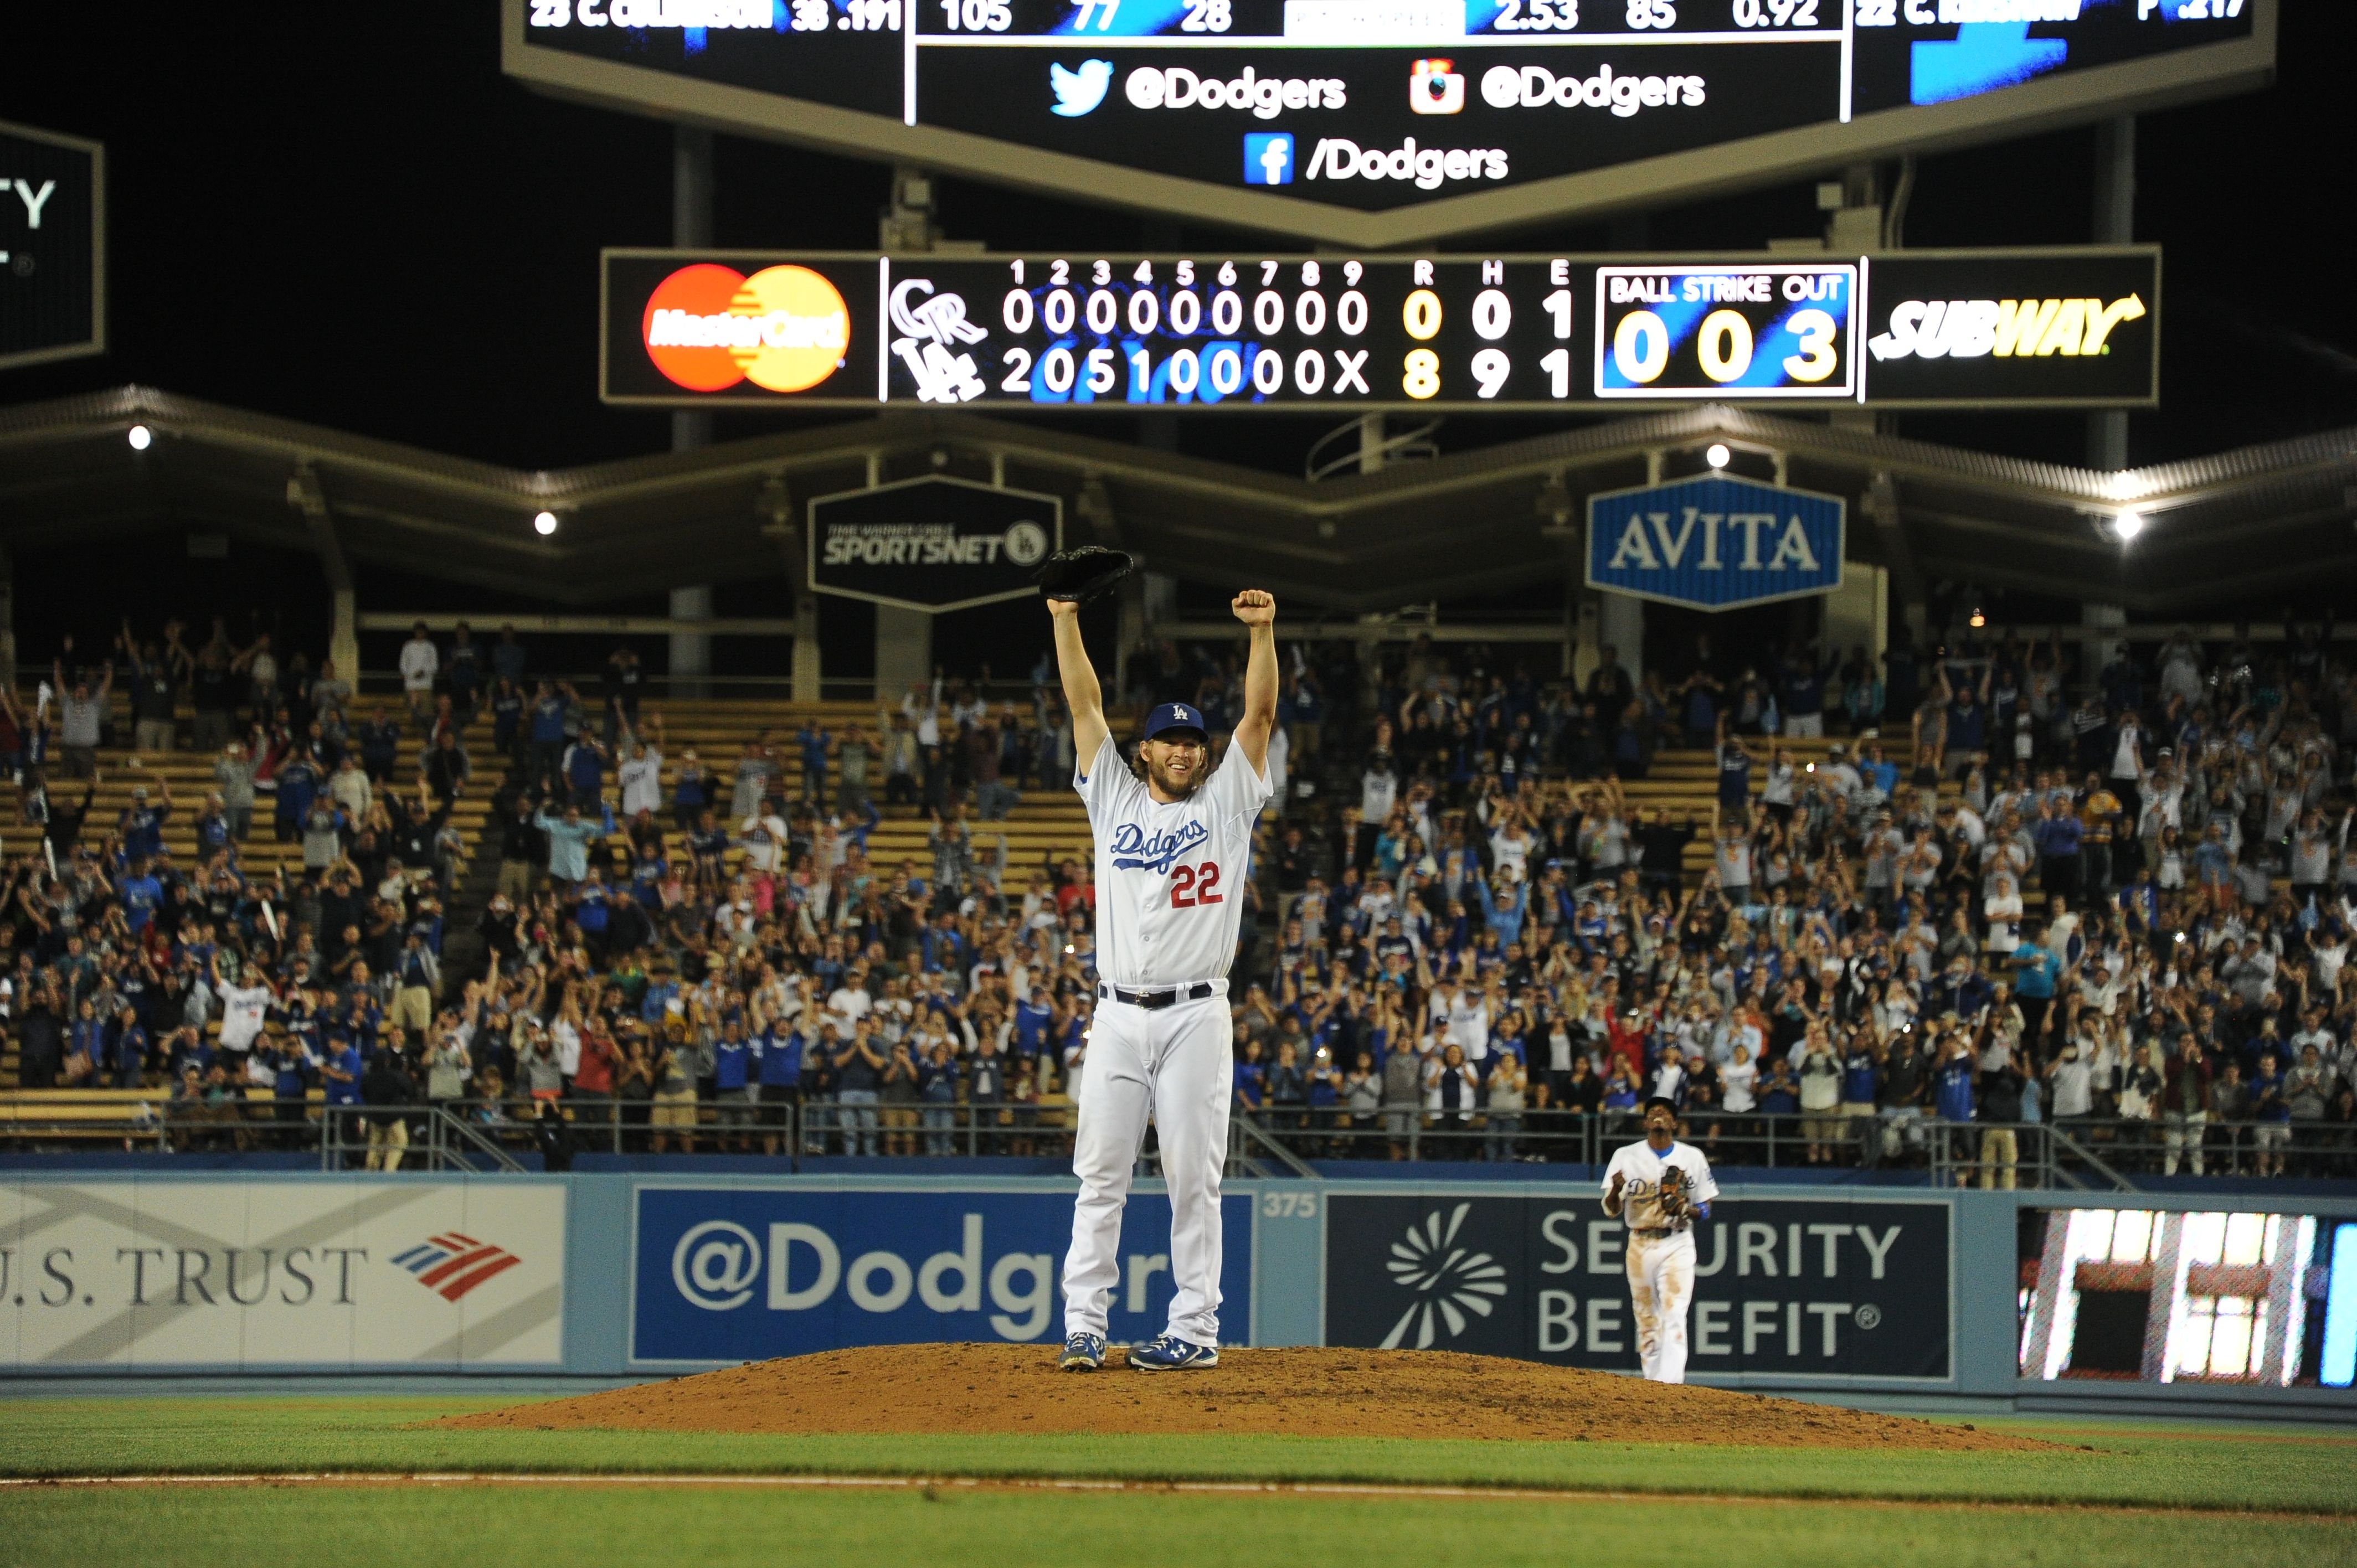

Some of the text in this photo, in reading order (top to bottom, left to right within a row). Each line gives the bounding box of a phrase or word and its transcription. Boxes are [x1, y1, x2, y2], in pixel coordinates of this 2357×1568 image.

[940, 0, 1819, 32] 105 77 28 2.53 85 0.92
[1125, 65, 1347, 120] @Dodgers
[1480, 63, 1706, 117] @Dodgers
[1305, 136, 1509, 191] /Dodgers
[0, 178, 55, 229] Y
[1010, 259, 1569, 286] 1 2 3 4 5 6 7 8 9 R H E
[1610, 275, 1844, 303] BALL STRIKE OUT
[1003, 288, 1033, 333] 0
[1045, 289, 1075, 334] 0
[1086, 290, 1116, 334] 0
[1128, 290, 1159, 334] 0
[1170, 290, 1200, 335] 0
[1212, 290, 1242, 335] 0
[1254, 291, 1284, 335] 0
[1295, 291, 1326, 335] 0
[1337, 291, 1368, 335] 0
[1403, 290, 1442, 340] 0
[1472, 290, 1511, 340] 0
[1542, 290, 1571, 338] 1
[1869, 293, 2146, 362] SUBWAY
[1614, 309, 1838, 383] 0 0 3
[1001, 348, 1031, 391] 2
[1044, 348, 1074, 393] 0
[1088, 349, 1115, 393] 5
[1131, 349, 1149, 393] 1
[1169, 349, 1200, 394] 0
[1211, 349, 1241, 394] 0
[1253, 349, 1283, 394] 0
[1295, 349, 1325, 394] 0
[1333, 350, 1370, 394] X
[1403, 349, 1440, 399] 8
[1471, 349, 1510, 398] 9
[1540, 349, 1568, 398] 1
[823, 535, 1003, 564] SPORTSNET
[1608, 506, 1820, 571] AVITA
[1110, 819, 1208, 875] Ddgers
[1171, 862, 1223, 909] 22
[1263, 1192, 1316, 1218] 375
[1541, 1210, 1902, 1279] SEURITY
[117, 1248, 368, 1307] TRUST
[672, 1213, 1170, 1342] @Dodgr
[1538, 1290, 1881, 1356] BEEFIT®
